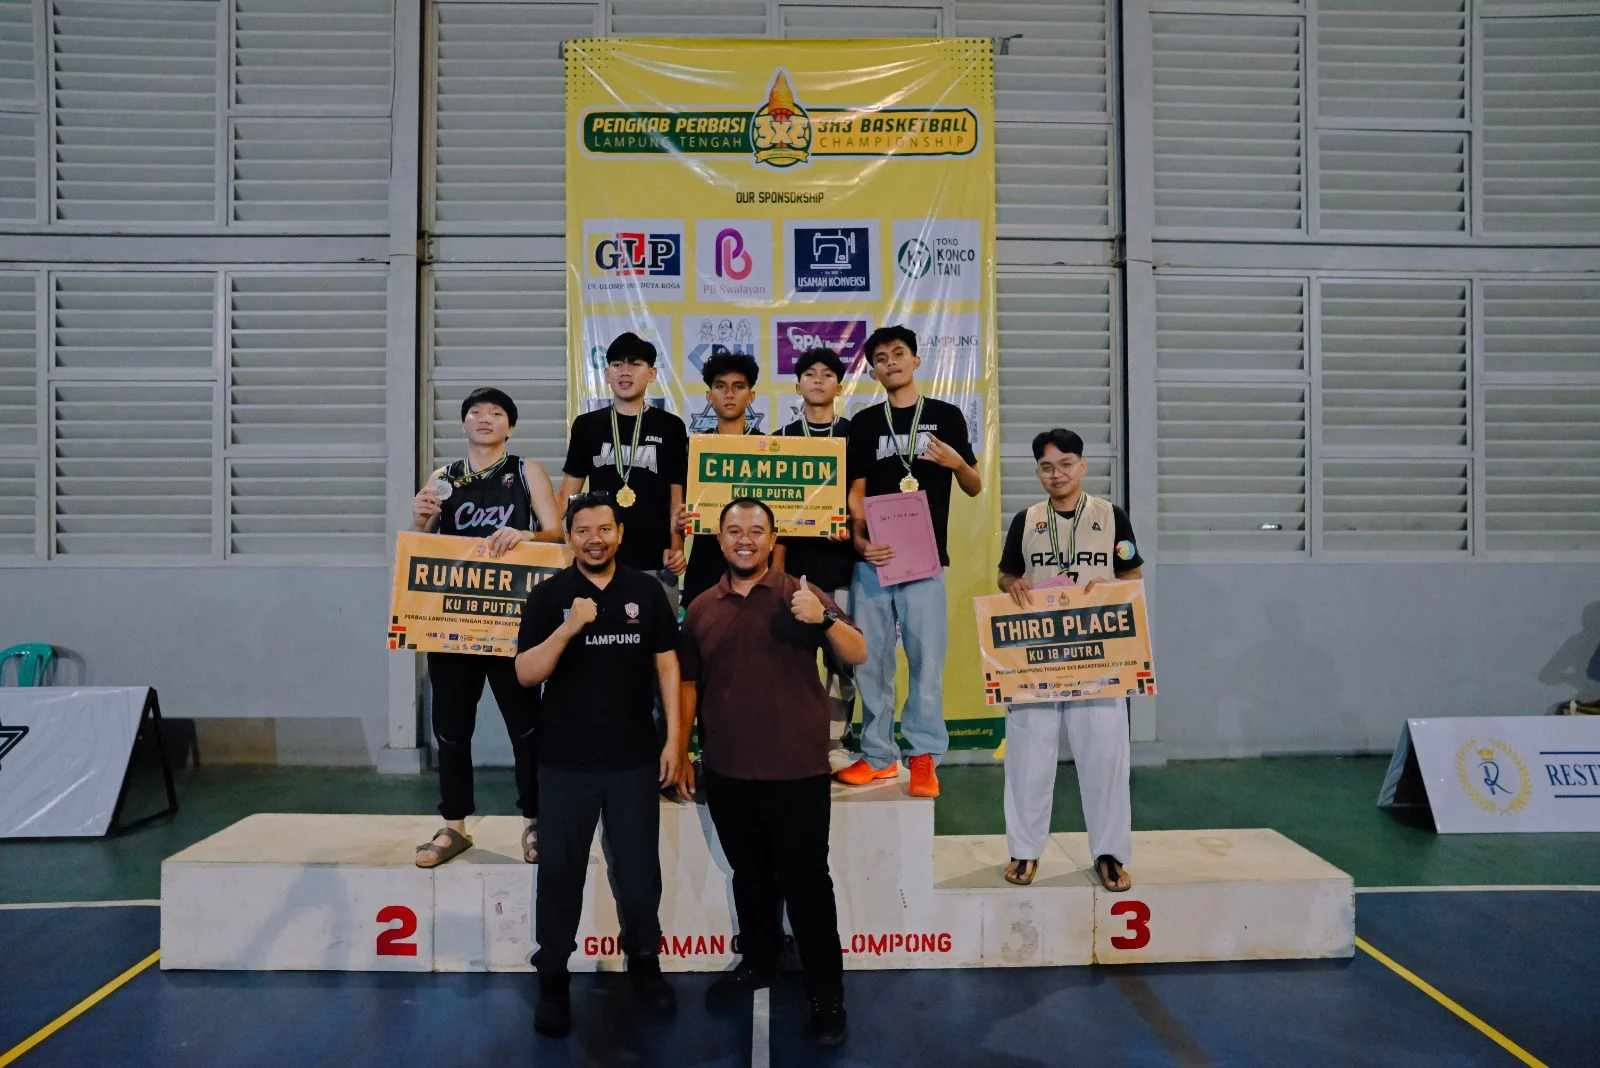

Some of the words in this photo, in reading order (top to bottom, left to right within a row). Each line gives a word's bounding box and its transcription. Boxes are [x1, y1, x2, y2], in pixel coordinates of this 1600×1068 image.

[592, 117, 670, 133] PENGKAB
[675, 117, 746, 133] PERBASI
[861, 117, 968, 133] BASKETBALL
[594, 136, 672, 148] LAMPUNG
[680, 136, 742, 148] TENGAH
[819, 135, 963, 148] CHAMPIONSHIP
[736, 192, 755, 204] OUR
[758, 192, 824, 204] SPONSORSHIP
[936, 237, 959, 246] TOKO
[595, 239, 674, 270] GLP
[937, 248, 975, 262] KONCO
[937, 263, 961, 277] TANI
[797, 276, 828, 287] USAMAH
[828, 276, 866, 287] KONVEKSI
[719, 284, 767, 296] Swalayan
[919, 335, 979, 347] LAMPUNG
[705, 458, 832, 480] CHAMPION
[734, 487, 748, 498] KU
[752, 487, 762, 498] 18
[767, 488, 802, 499] PUTRA
[454, 501, 515, 531] Cozy
[1030, 551, 1108, 567] AZURA
[414, 563, 513, 592] RUNNER
[525, 572, 554, 593] U
[445, 598, 462, 611] KU
[466, 600, 479, 612] 18
[482, 601, 522, 615] PUTRA
[428, 615, 458, 623] LAMPUNG
[995, 617, 1055, 642] THIRD
[1062, 610, 1130, 636] PLACE
[585, 633, 641, 645] LAMPUNG
[1029, 649, 1044, 662] KU
[1048, 648, 1059, 660] 18
[1063, 645, 1102, 659] PUTRA
[1077, 662, 1111, 670] BASKETBALL
[1544, 764, 1600, 786] REST
[375, 905, 418, 957] 2
[1110, 900, 1151, 950] 3
[657, 935, 725, 958] AMAN
